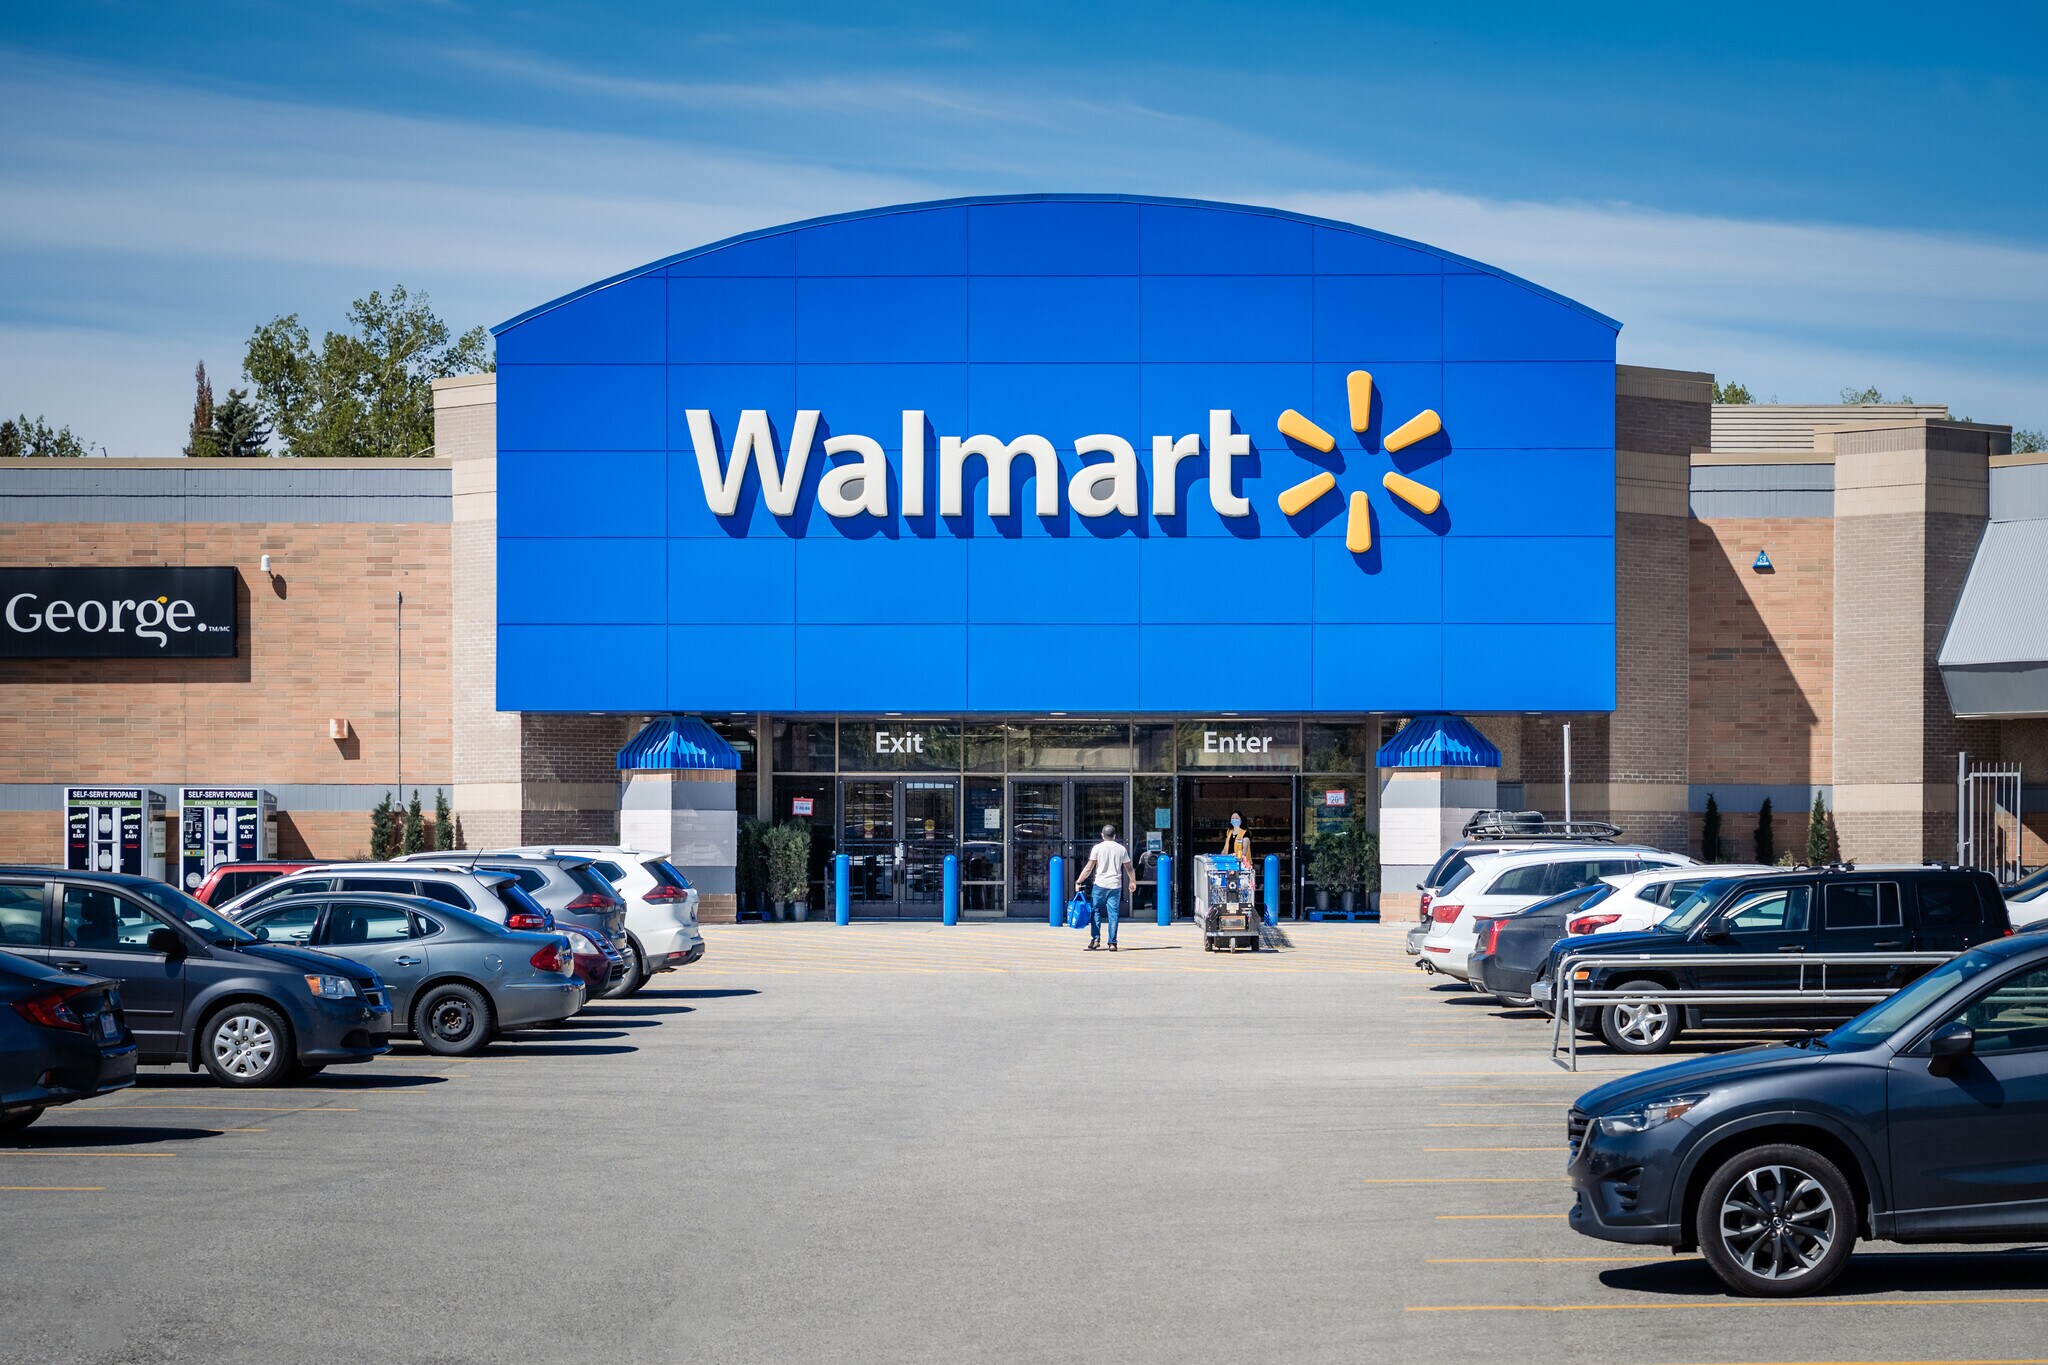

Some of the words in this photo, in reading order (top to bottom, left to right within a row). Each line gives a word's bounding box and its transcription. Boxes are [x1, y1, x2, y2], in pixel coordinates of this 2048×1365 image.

[685, 409, 1251, 518] Walmart
[875, 731, 924, 754] Exit
[1203, 731, 1273, 754] Enter
